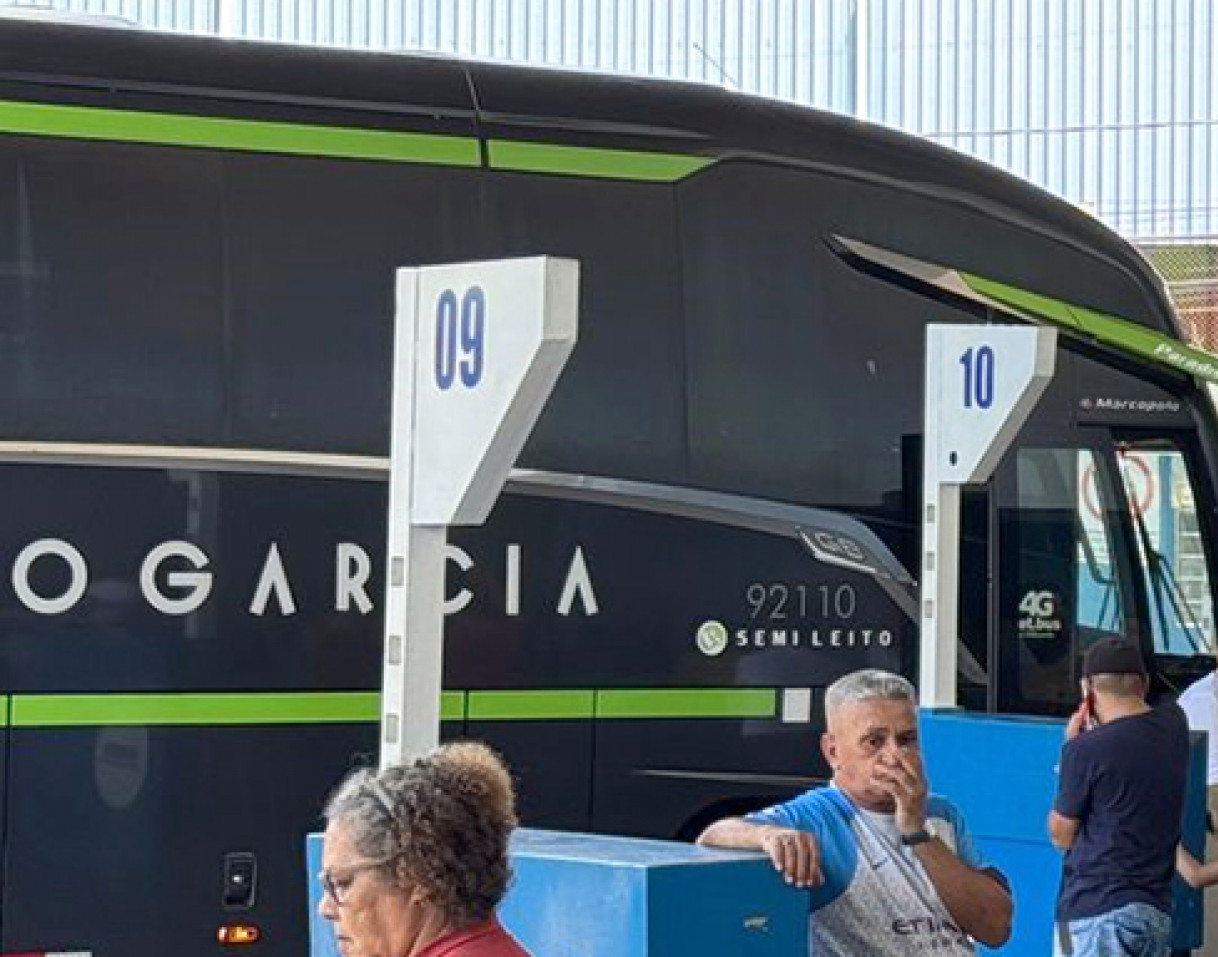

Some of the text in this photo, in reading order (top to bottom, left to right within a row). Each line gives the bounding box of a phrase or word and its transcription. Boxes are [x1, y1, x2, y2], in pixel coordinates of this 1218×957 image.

[435, 285, 485, 390] 09
[959, 345, 995, 409] 10
[1096, 398, 1180, 413] Marcopolo
[747, 582, 856, 619] 92110
[1018, 590, 1054, 617] 4G
[735, 629, 891, 646] SEMI LEITO
